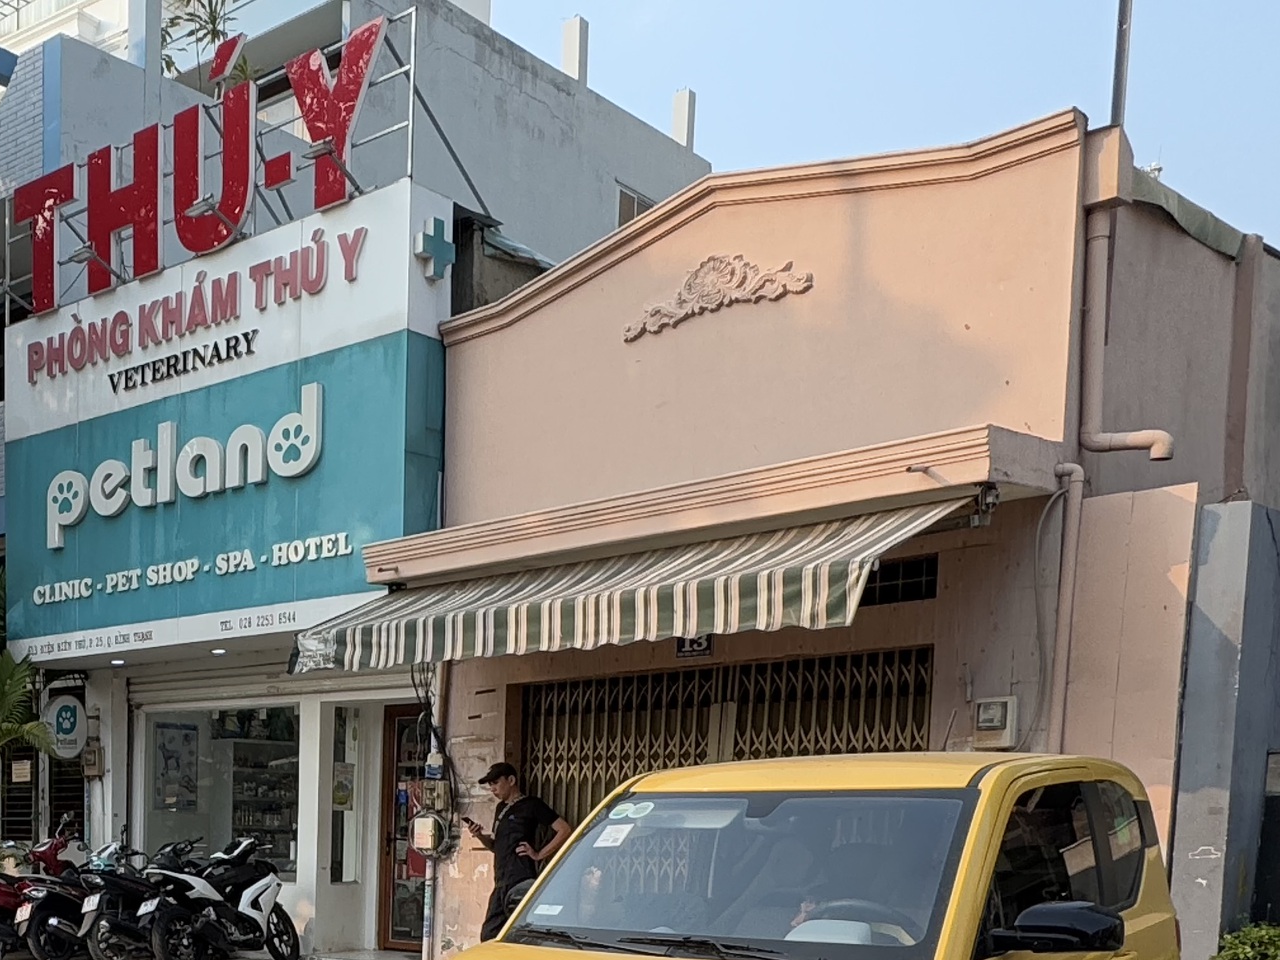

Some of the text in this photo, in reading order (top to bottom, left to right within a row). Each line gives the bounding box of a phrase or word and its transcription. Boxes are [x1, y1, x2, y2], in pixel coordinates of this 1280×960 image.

[26, 227, 368, 386] PHÒNG KHÁM THÚ Y
[107, 329, 260, 395] VETERINARY
[47, 382, 324, 550] petland
[32, 577, 93, 605] CLINIC
[105, 568, 142, 594] PET
[146, 557, 199, 586] SHOP
[215, 548, 255, 575] SPA
[271, 532, 353, 567] HOTEL
[681, 635, 708, 651] 13
